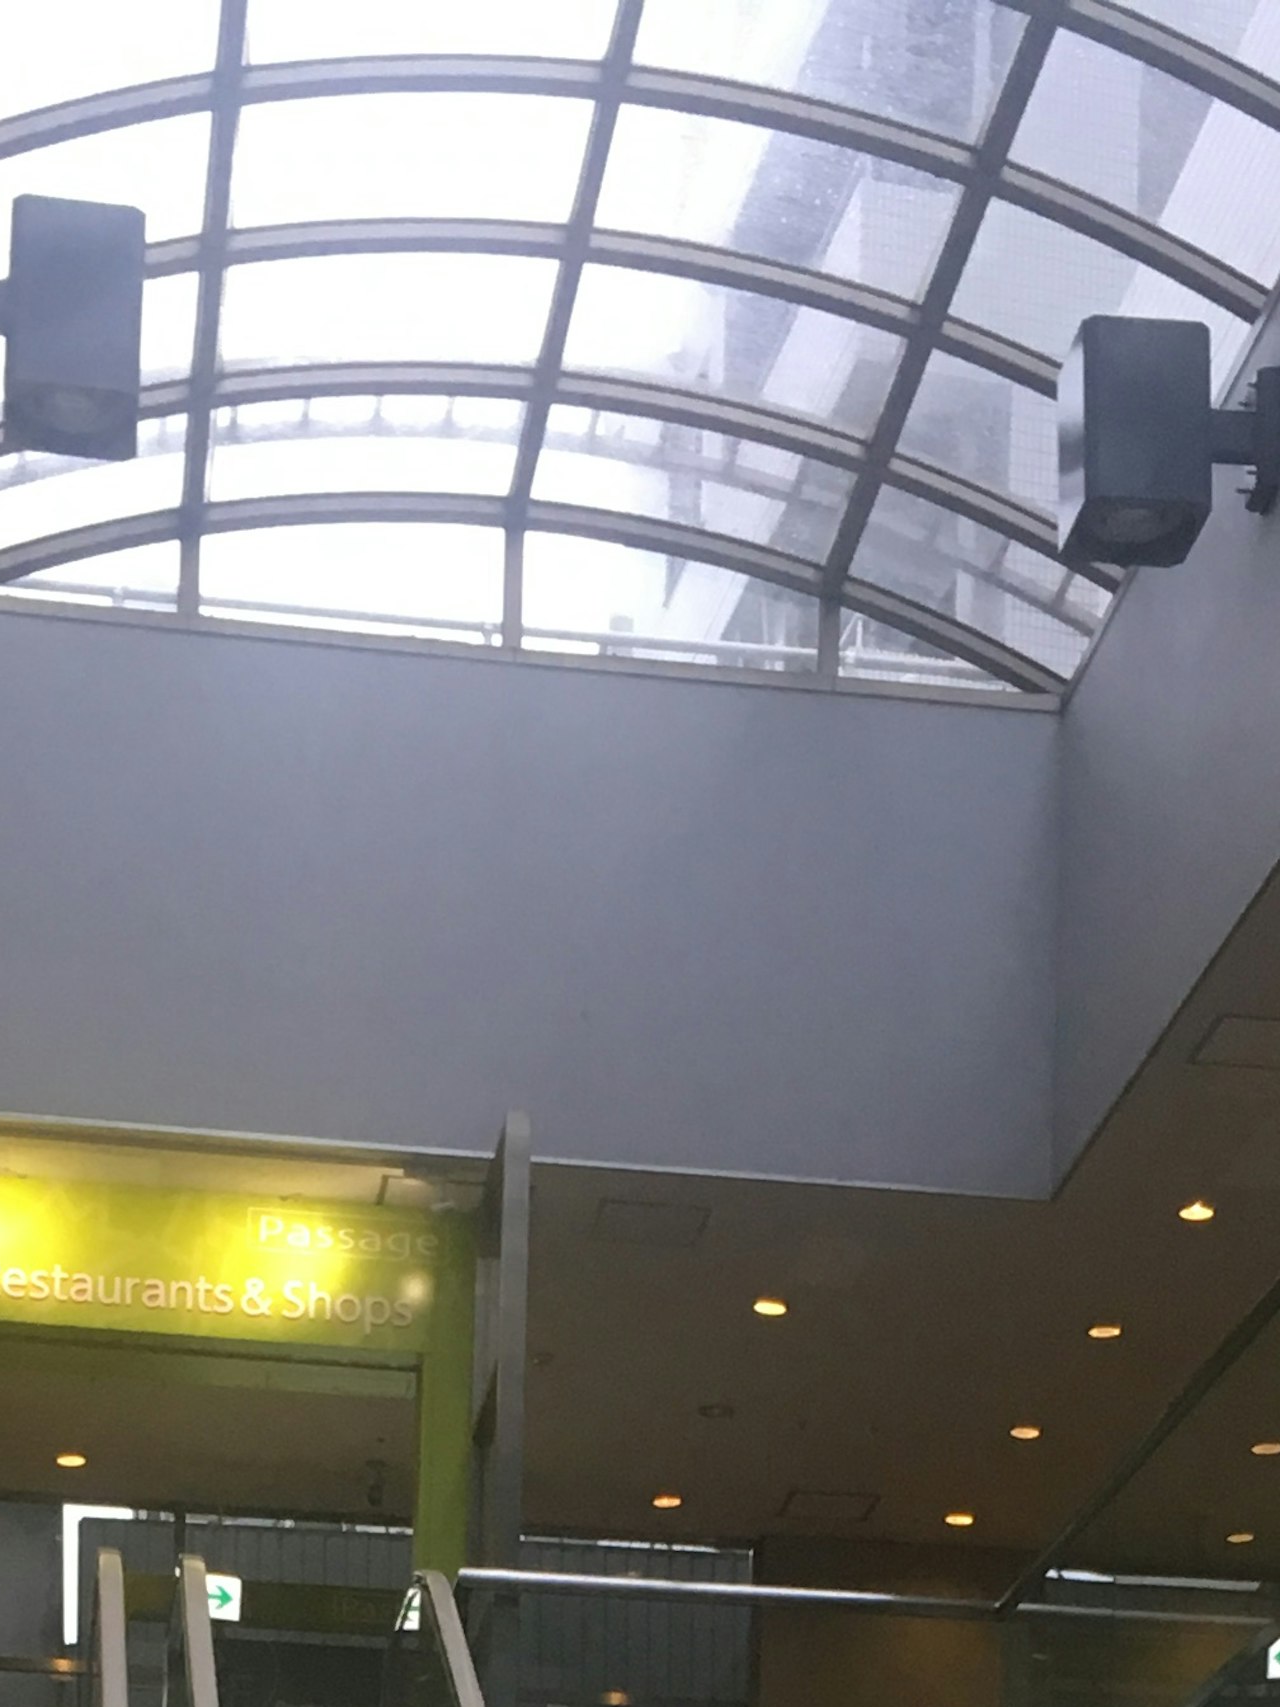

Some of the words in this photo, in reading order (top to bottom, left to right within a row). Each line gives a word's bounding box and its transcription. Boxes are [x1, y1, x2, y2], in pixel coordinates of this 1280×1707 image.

[259, 1214, 439, 1257] Passage
[240, 1278, 271, 1317] &
[282, 1280, 412, 1334] Shops
